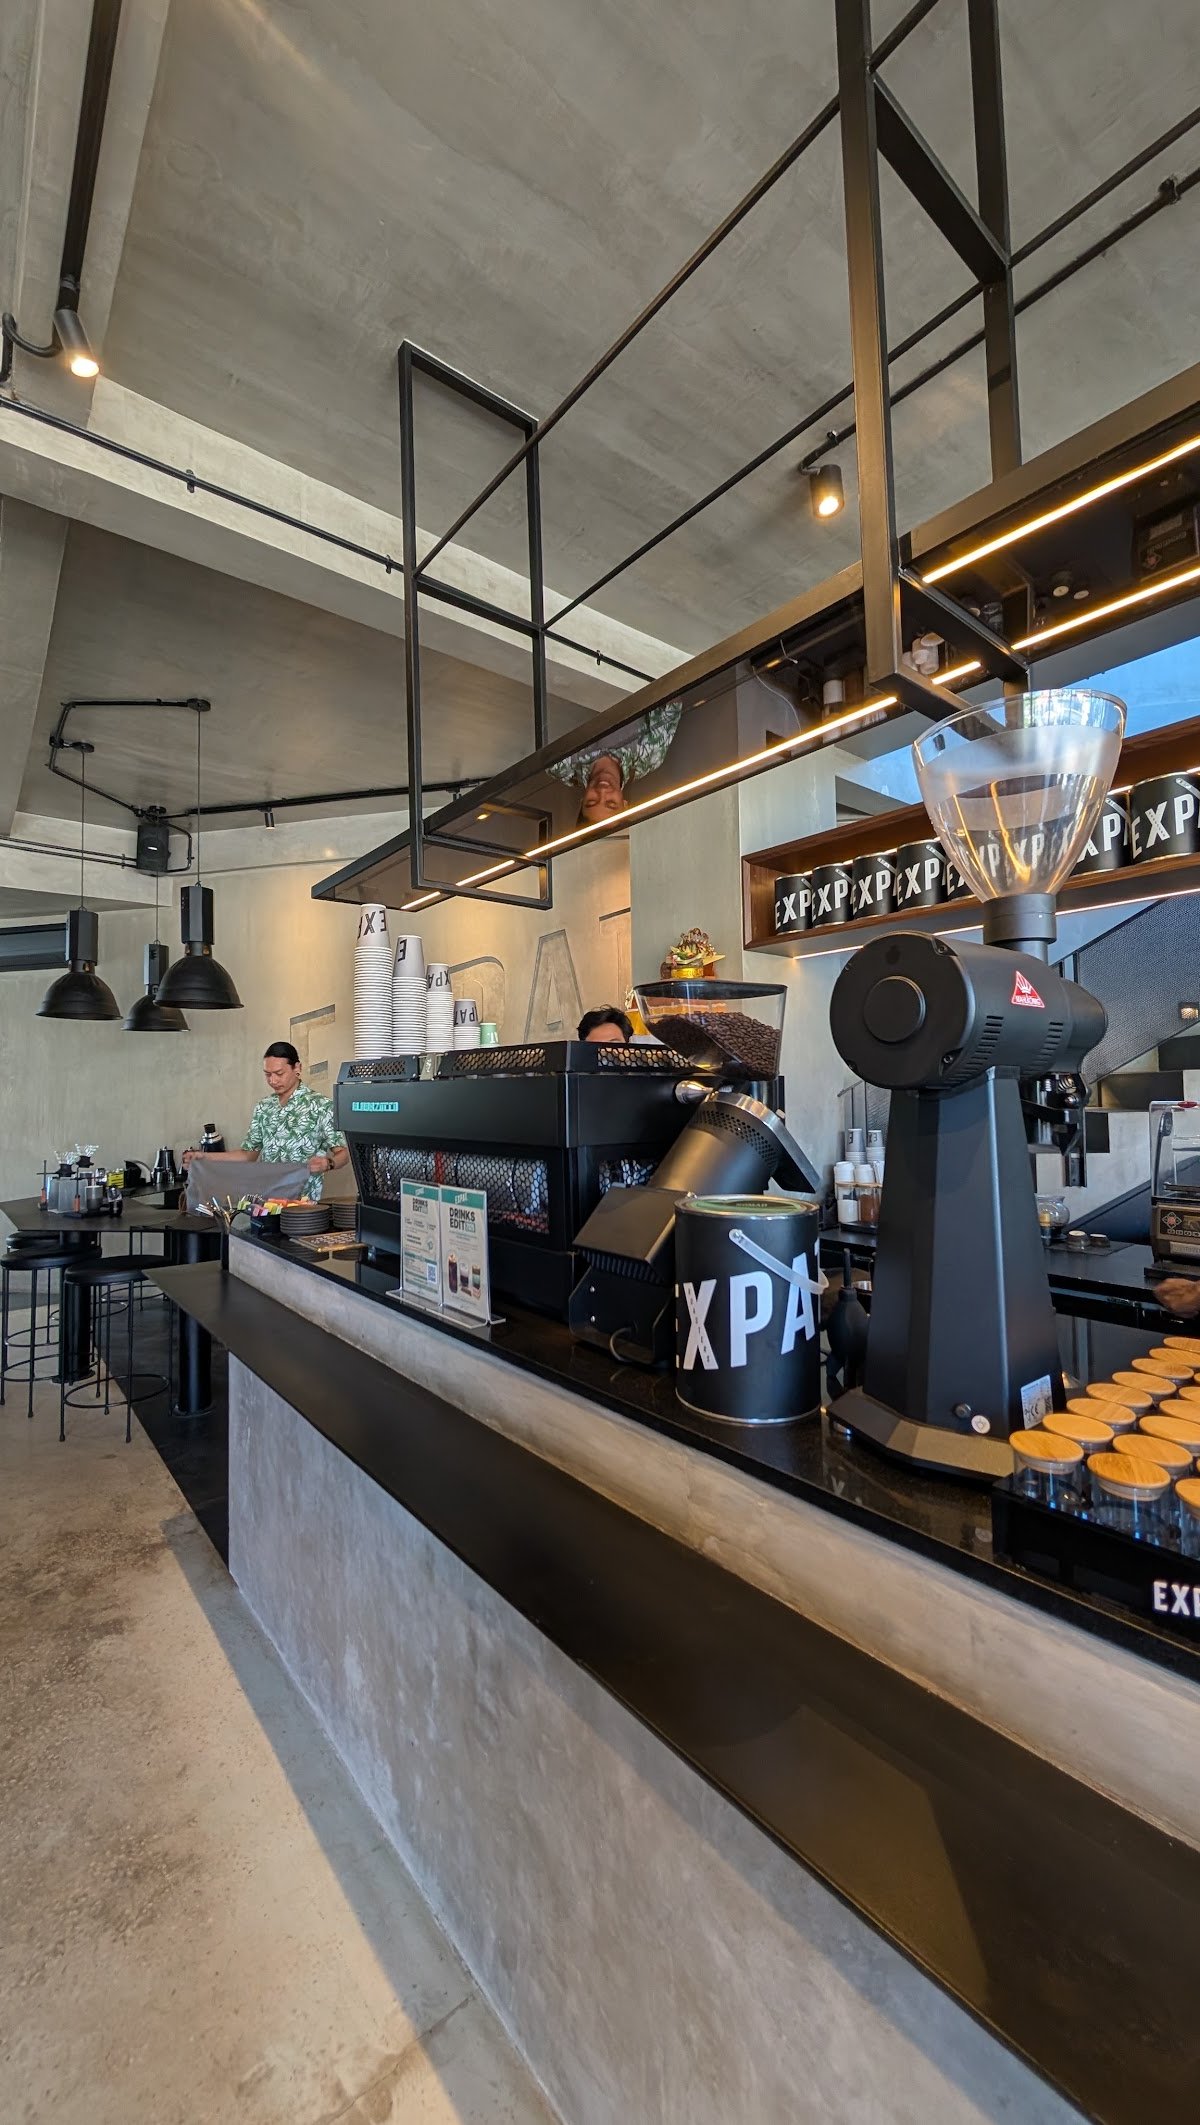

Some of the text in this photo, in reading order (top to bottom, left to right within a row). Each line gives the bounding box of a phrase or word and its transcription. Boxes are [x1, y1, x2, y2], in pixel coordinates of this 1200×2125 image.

[1131, 793, 1200, 859] EXP
[811, 878, 852, 922] EXP
[852, 869, 898, 914] EXP
[897, 857, 946, 907] EXP
[775, 888, 812, 931] EXP
[449, 1207, 476, 1222] DRINKS
[449, 1218, 466, 1231] EDIT
[675, 1238, 821, 1370] XPA
